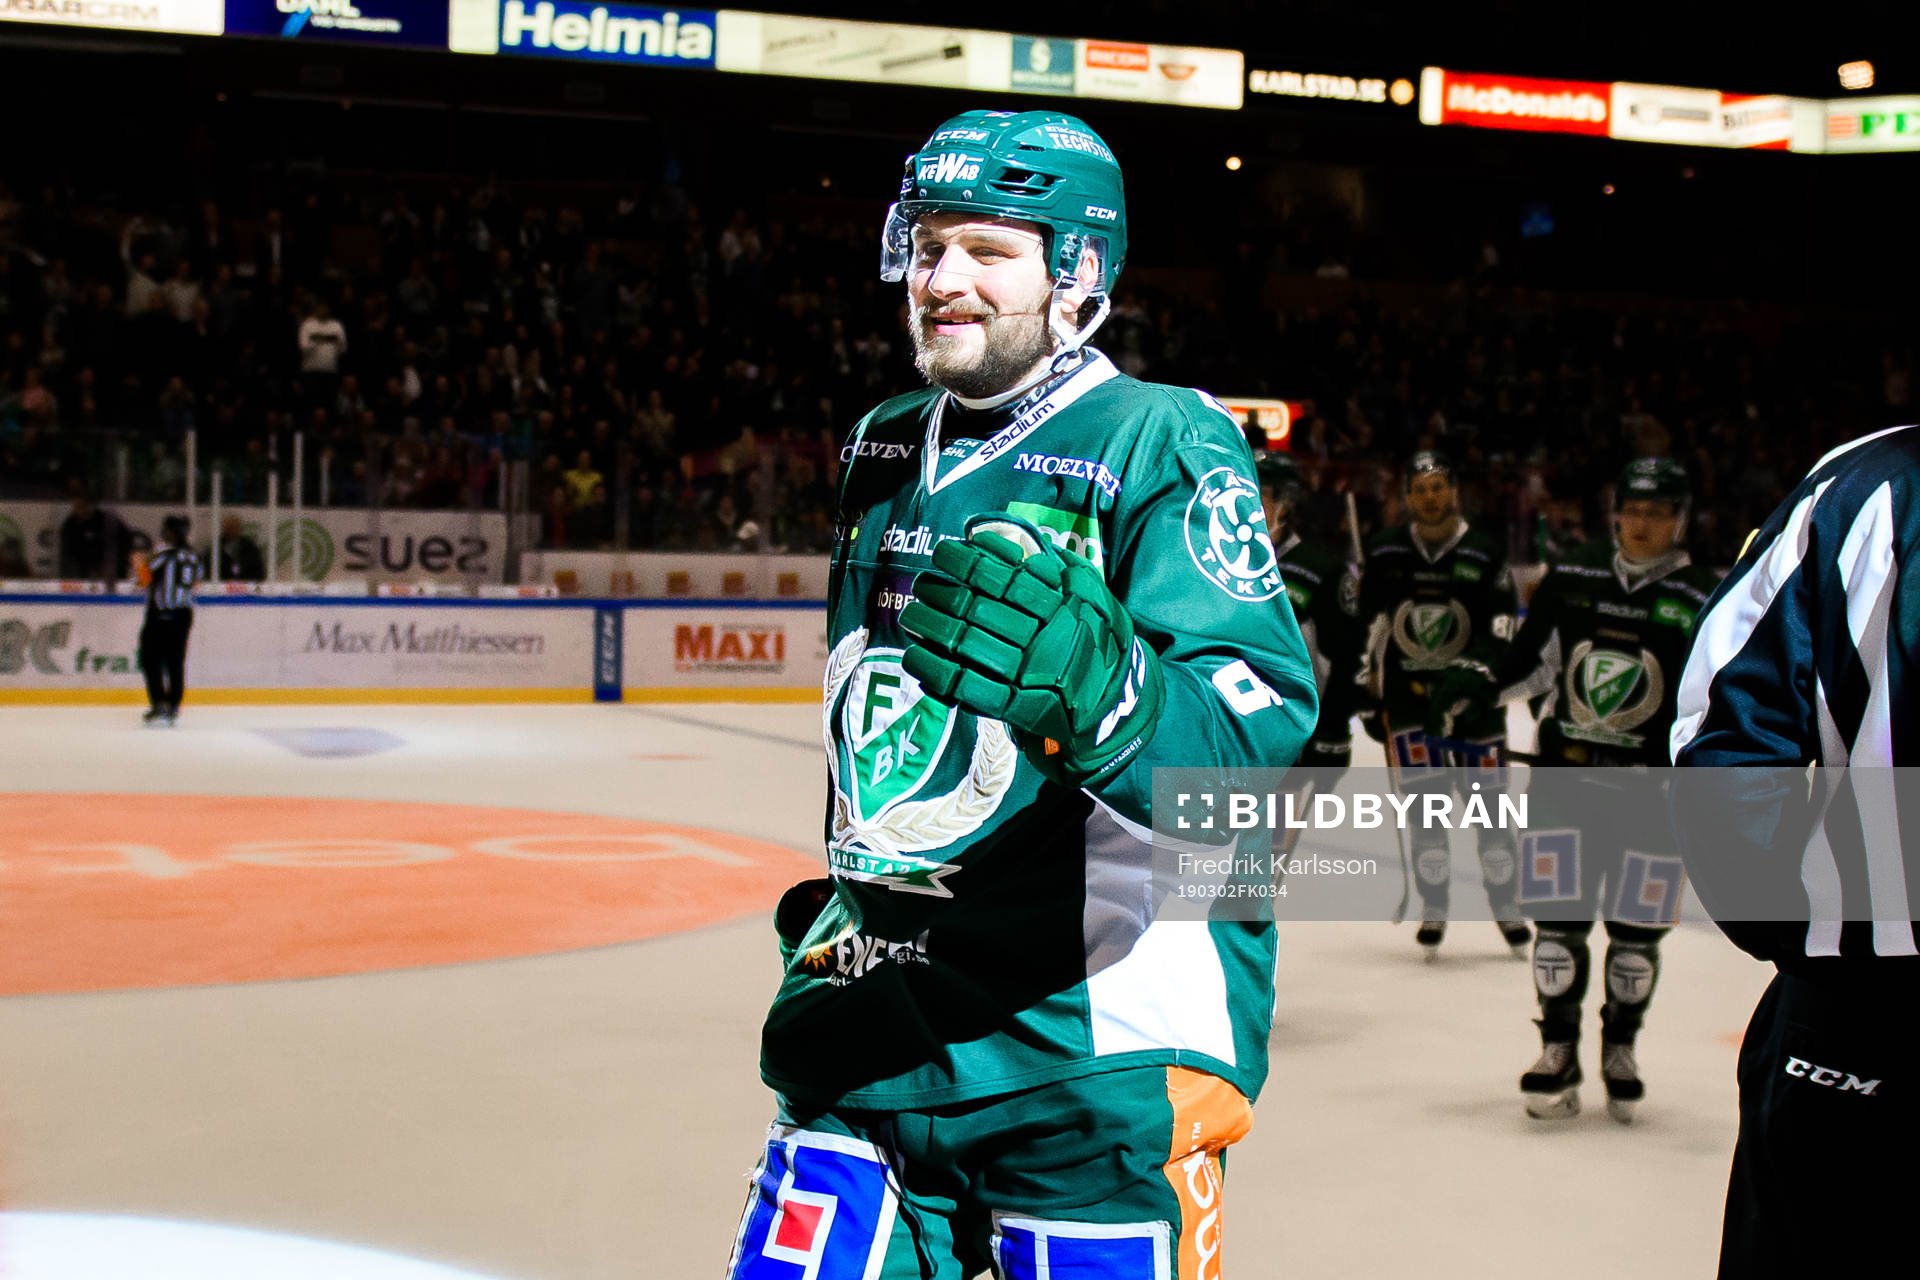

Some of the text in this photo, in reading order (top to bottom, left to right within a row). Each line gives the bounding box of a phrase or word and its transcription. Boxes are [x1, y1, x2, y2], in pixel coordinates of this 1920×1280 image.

[502, 0, 713, 59] Helmia
[1249, 70, 1386, 103] KARLSTAD.SE
[1448, 84, 1606, 123] McDonald's
[935, 130, 987, 141] CCM
[1085, 205, 1118, 221] CCM
[980, 400, 1056, 461] stadium
[941, 447, 967, 458] SHL
[304, 619, 376, 653] Max
[674, 624, 786, 661] MAXI
[1785, 1056, 1882, 1095] CCM
